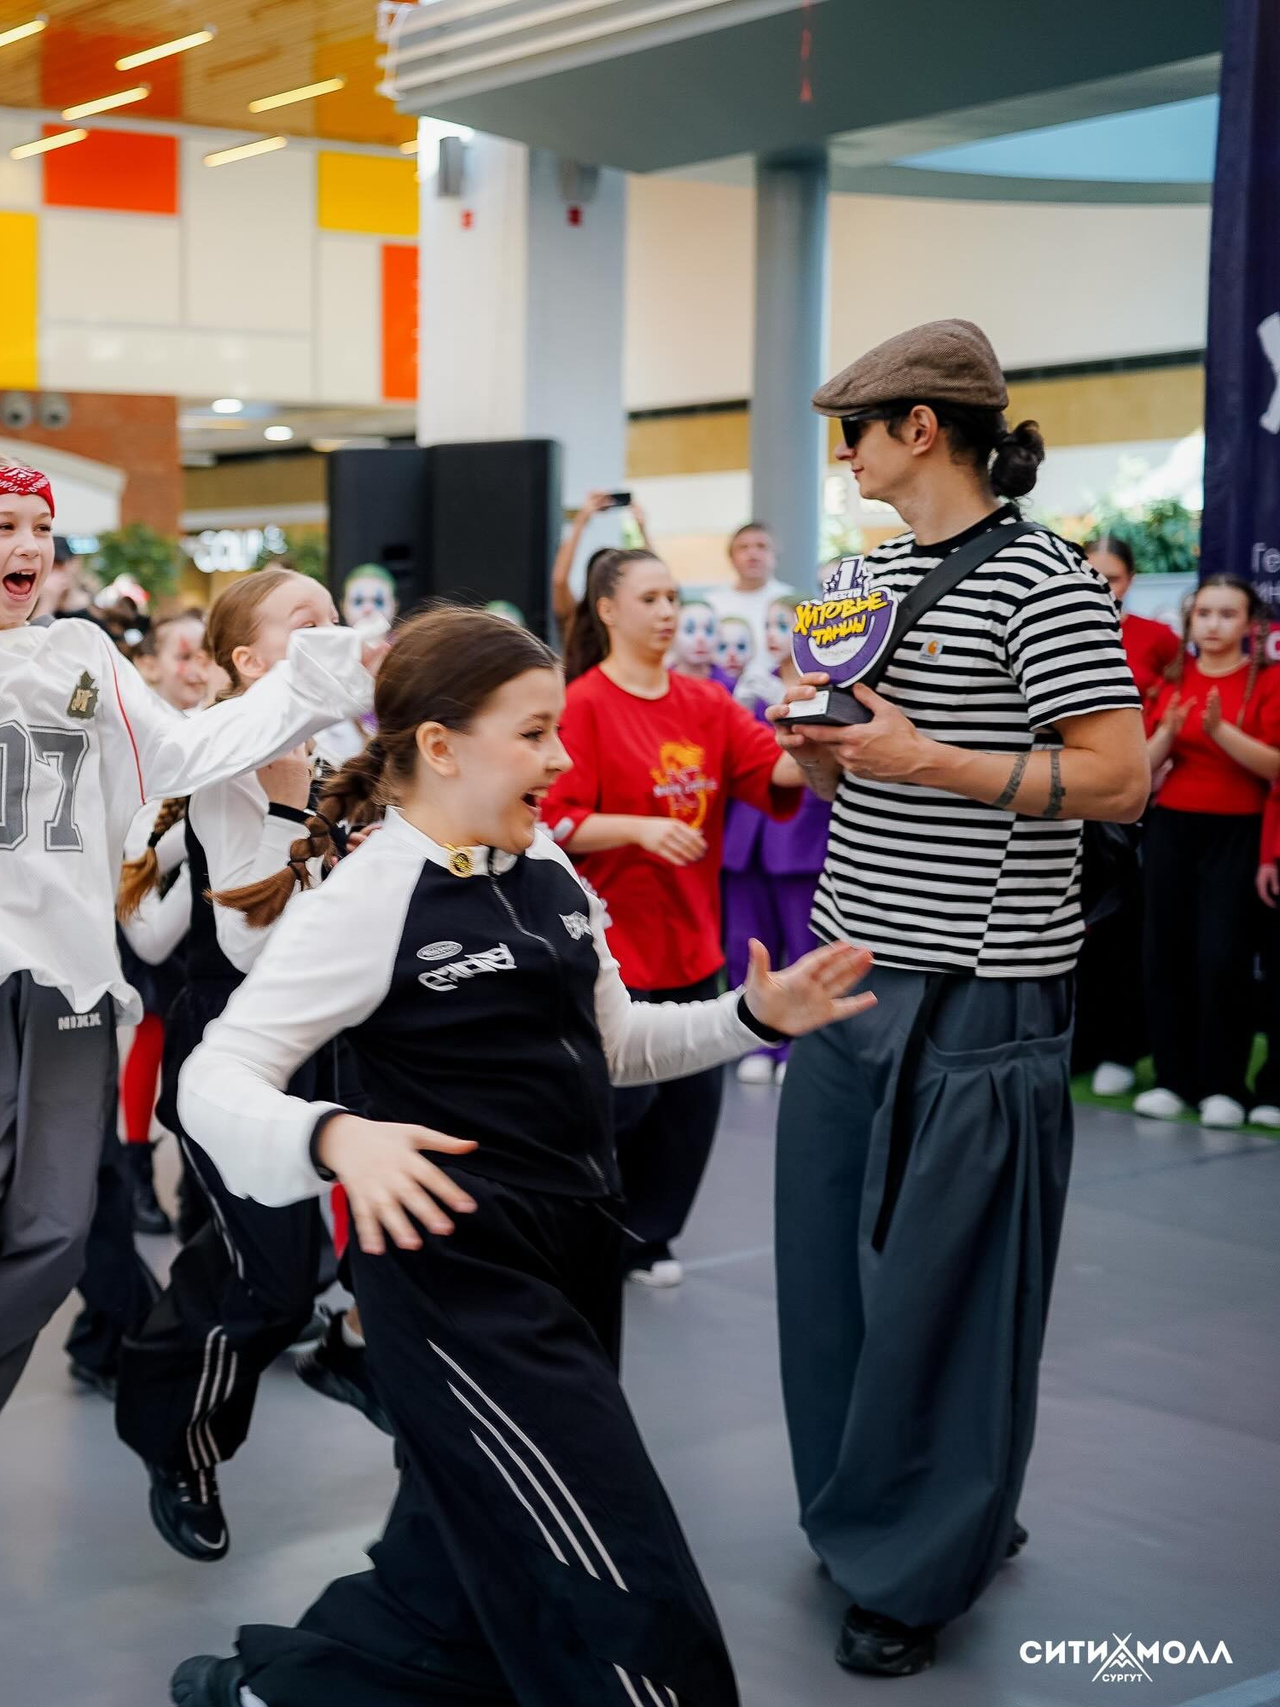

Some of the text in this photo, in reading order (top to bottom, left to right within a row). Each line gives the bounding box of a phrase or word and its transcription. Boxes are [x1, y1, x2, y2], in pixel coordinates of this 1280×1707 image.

[837, 559, 859, 590] 1
[794, 592, 888, 636] ХИТОВЫЕ
[811, 614, 867, 646] ТАНЦЫ
